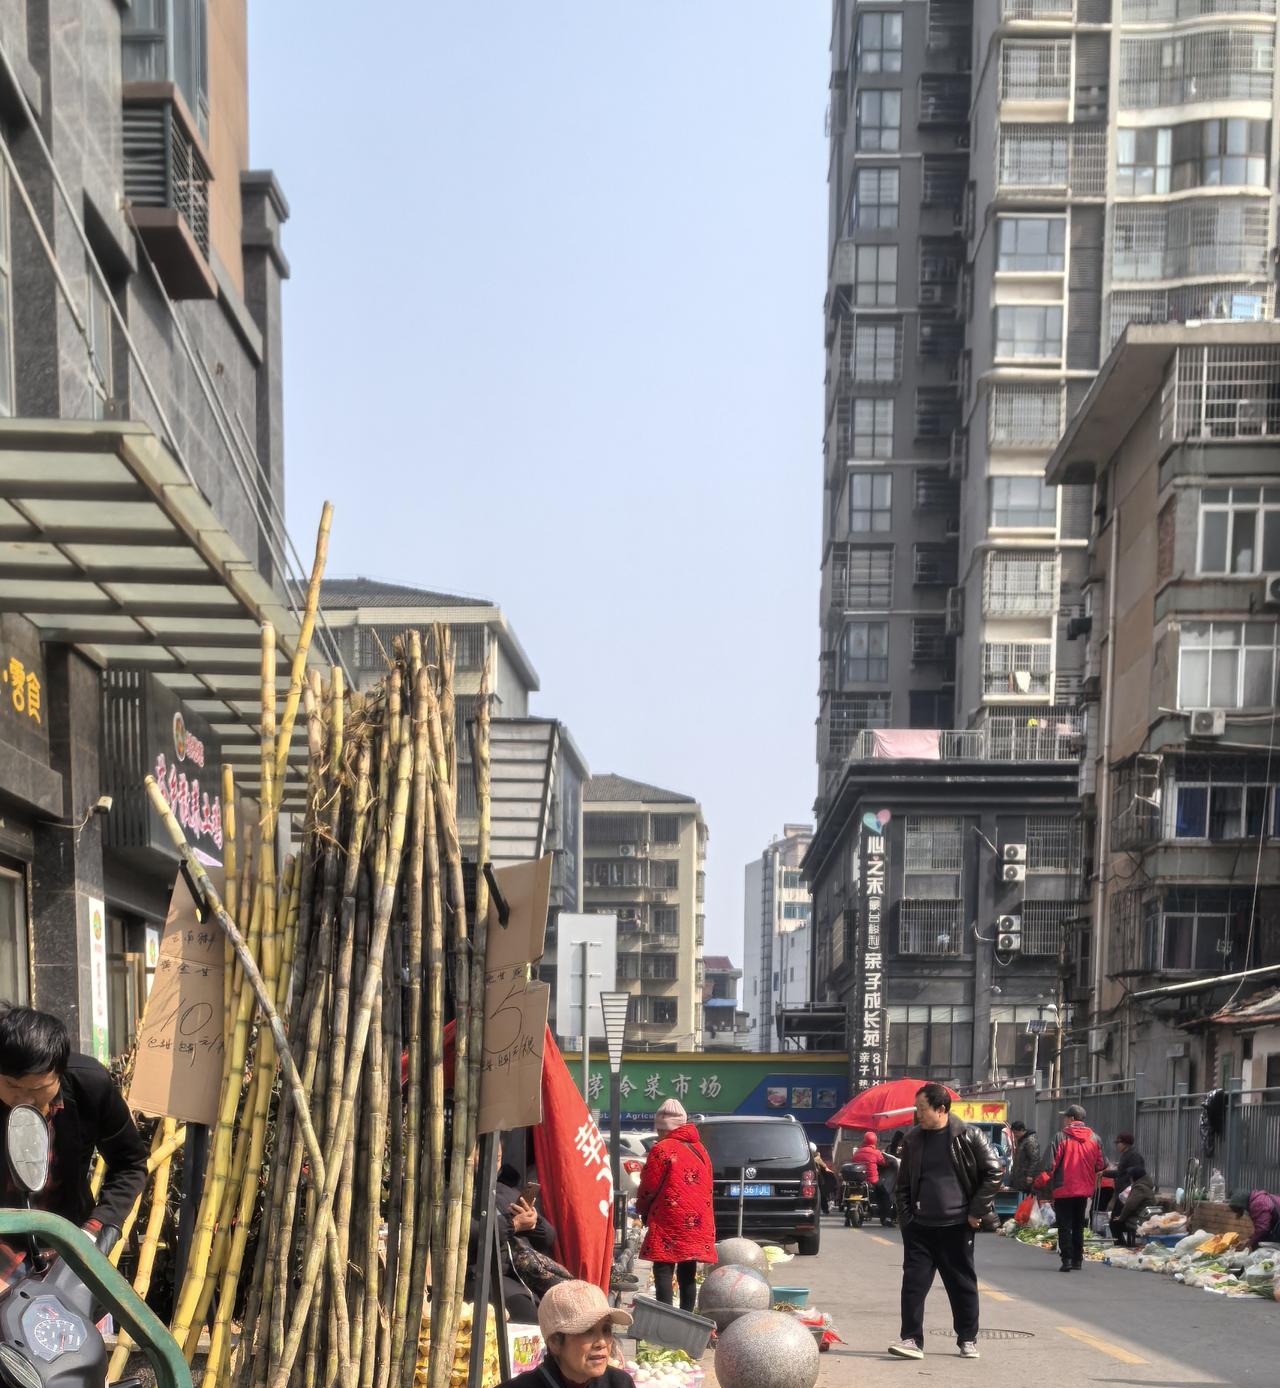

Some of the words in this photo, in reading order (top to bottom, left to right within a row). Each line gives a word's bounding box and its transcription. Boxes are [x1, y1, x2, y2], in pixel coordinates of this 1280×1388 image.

[3, 656, 41, 724] 零食
[160, 998, 213, 1036] 10
[482, 985, 524, 1054] 5
